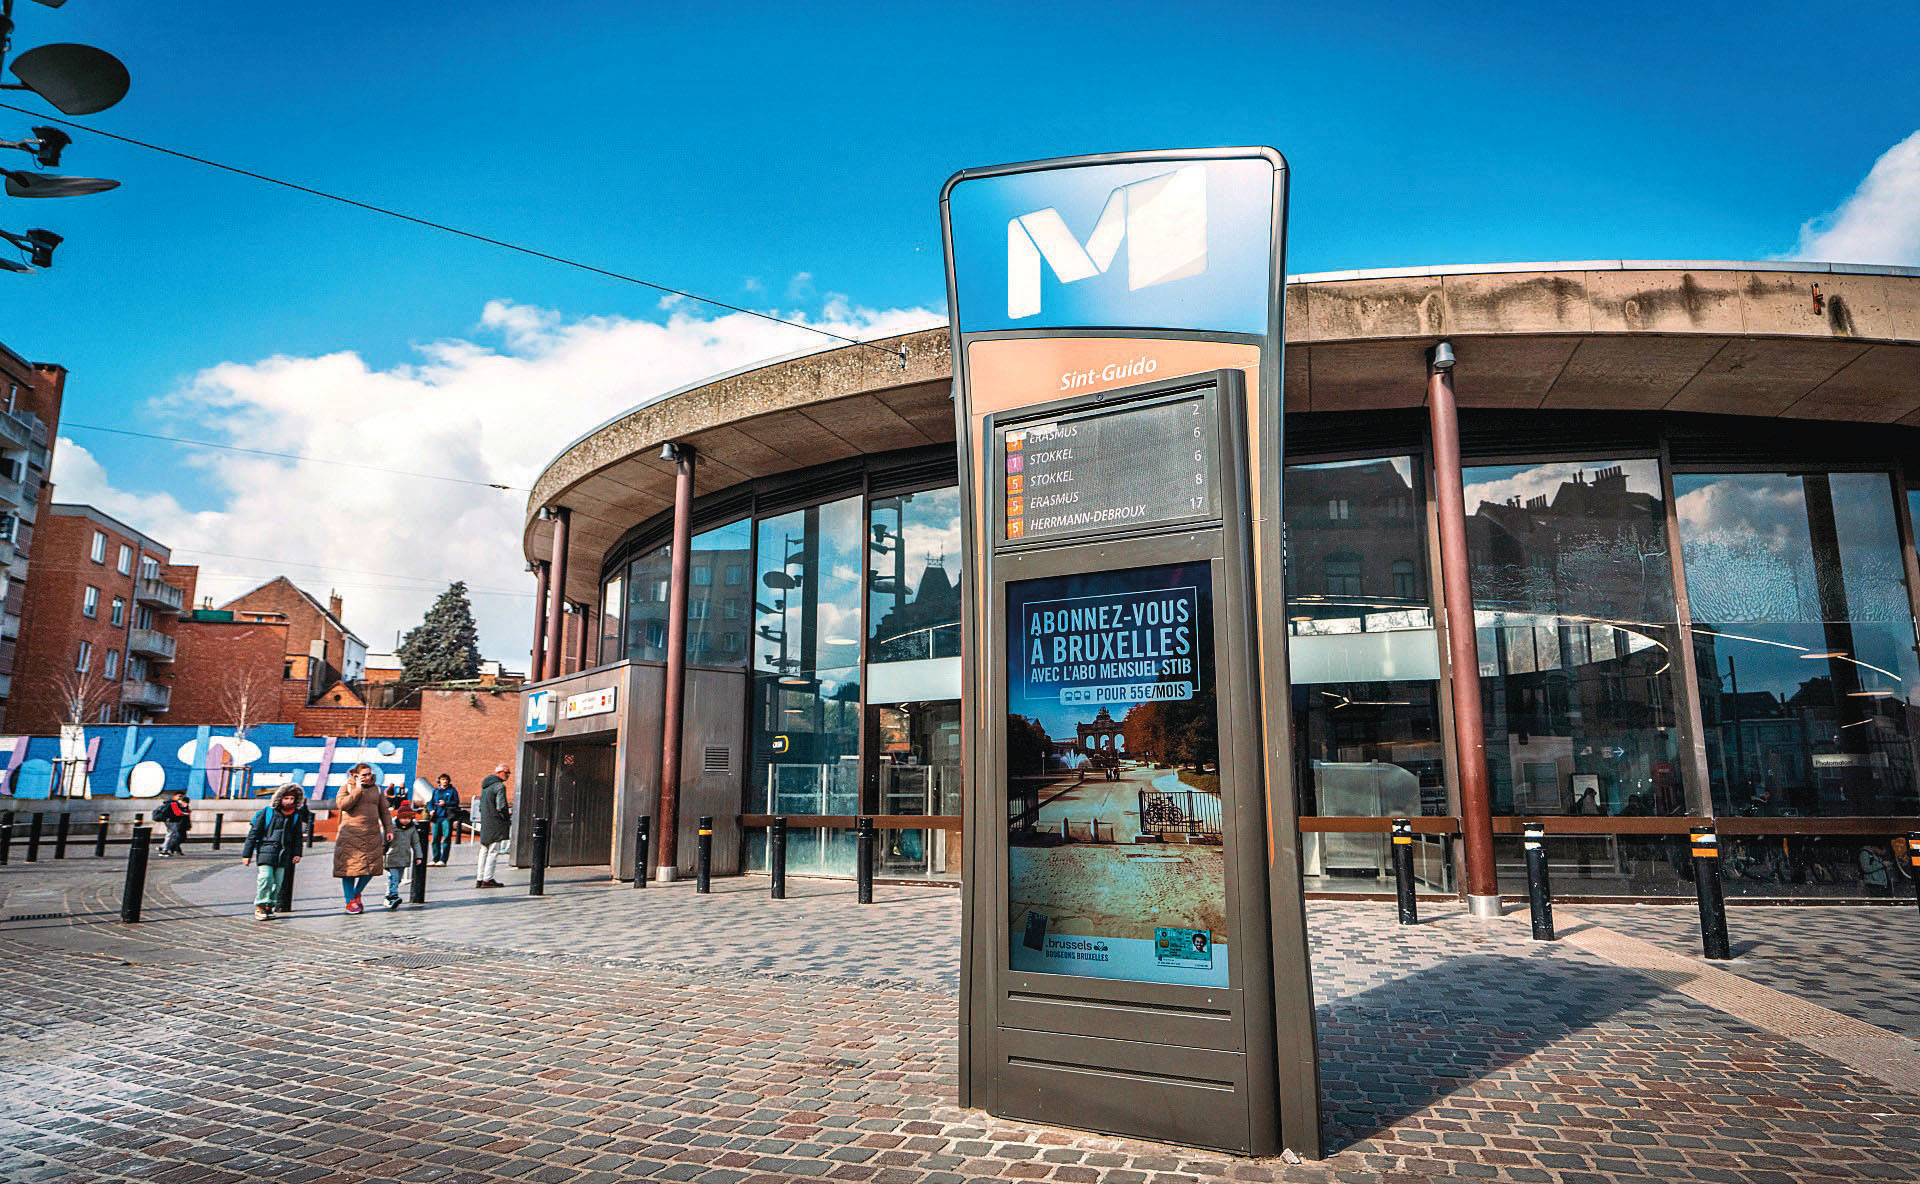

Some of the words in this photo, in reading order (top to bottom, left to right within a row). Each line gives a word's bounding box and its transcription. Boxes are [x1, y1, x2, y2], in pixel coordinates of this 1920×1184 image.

[1007, 164, 1209, 320] M
[1060, 357, 1157, 391] Sint-Guido
[1030, 425, 1078, 444] ERASMUS
[1192, 403, 1200, 416] 2
[1012, 457, 1017, 468] 1
[1030, 448, 1074, 465] STOKKEL
[1193, 426, 1201, 438] 6
[1012, 478, 1018, 490] 5
[1030, 469, 1075, 487] STOKKEL
[1194, 449, 1202, 461] 6
[1012, 500, 1019, 512] 5
[1030, 491, 1079, 509] ERASMUS
[1195, 473, 1203, 485] 8
[1012, 522, 1019, 534] 5
[1030, 504, 1147, 531] HERRMANN-DEBROUX
[1190, 496, 1204, 510] 17
[1030, 598, 1190, 635] ABONNEZ-VOUS
[1053, 626, 1191, 664] BRUXELLES
[1031, 666, 1060, 683] AVEC
[1063, 664, 1097, 681] L'ABO
[1100, 660, 1160, 679] MENSUEL
[1162, 658, 1192, 675] STIB
[527, 693, 548, 727] M
[1096, 687, 1127, 701] POUR
[1130, 684, 1186, 700] 55€/MOIS
[1076, 952, 1109, 962] BRUXELLES
